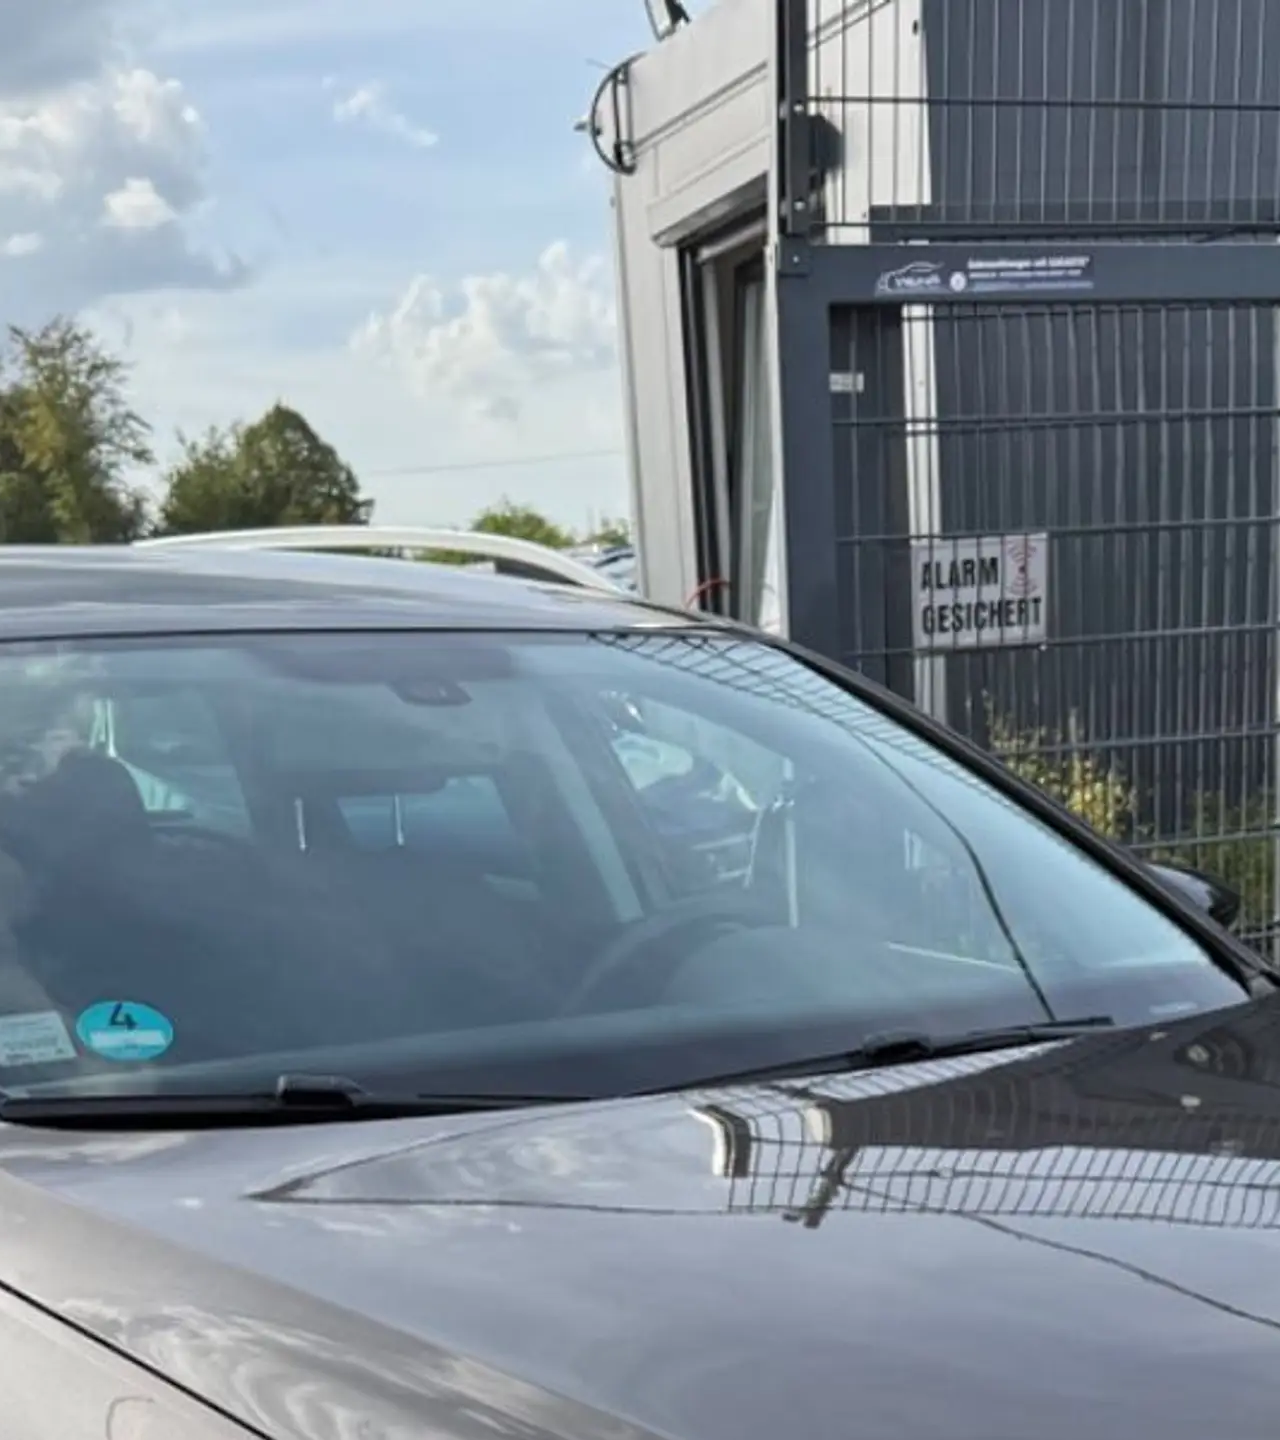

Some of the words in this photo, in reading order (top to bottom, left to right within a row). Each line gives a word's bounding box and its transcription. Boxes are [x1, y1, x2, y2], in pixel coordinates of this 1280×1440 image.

[922, 557, 999, 590] ALARM
[922, 597, 1042, 635] GESICHERT
[109, 1002, 139, 1030] 4
